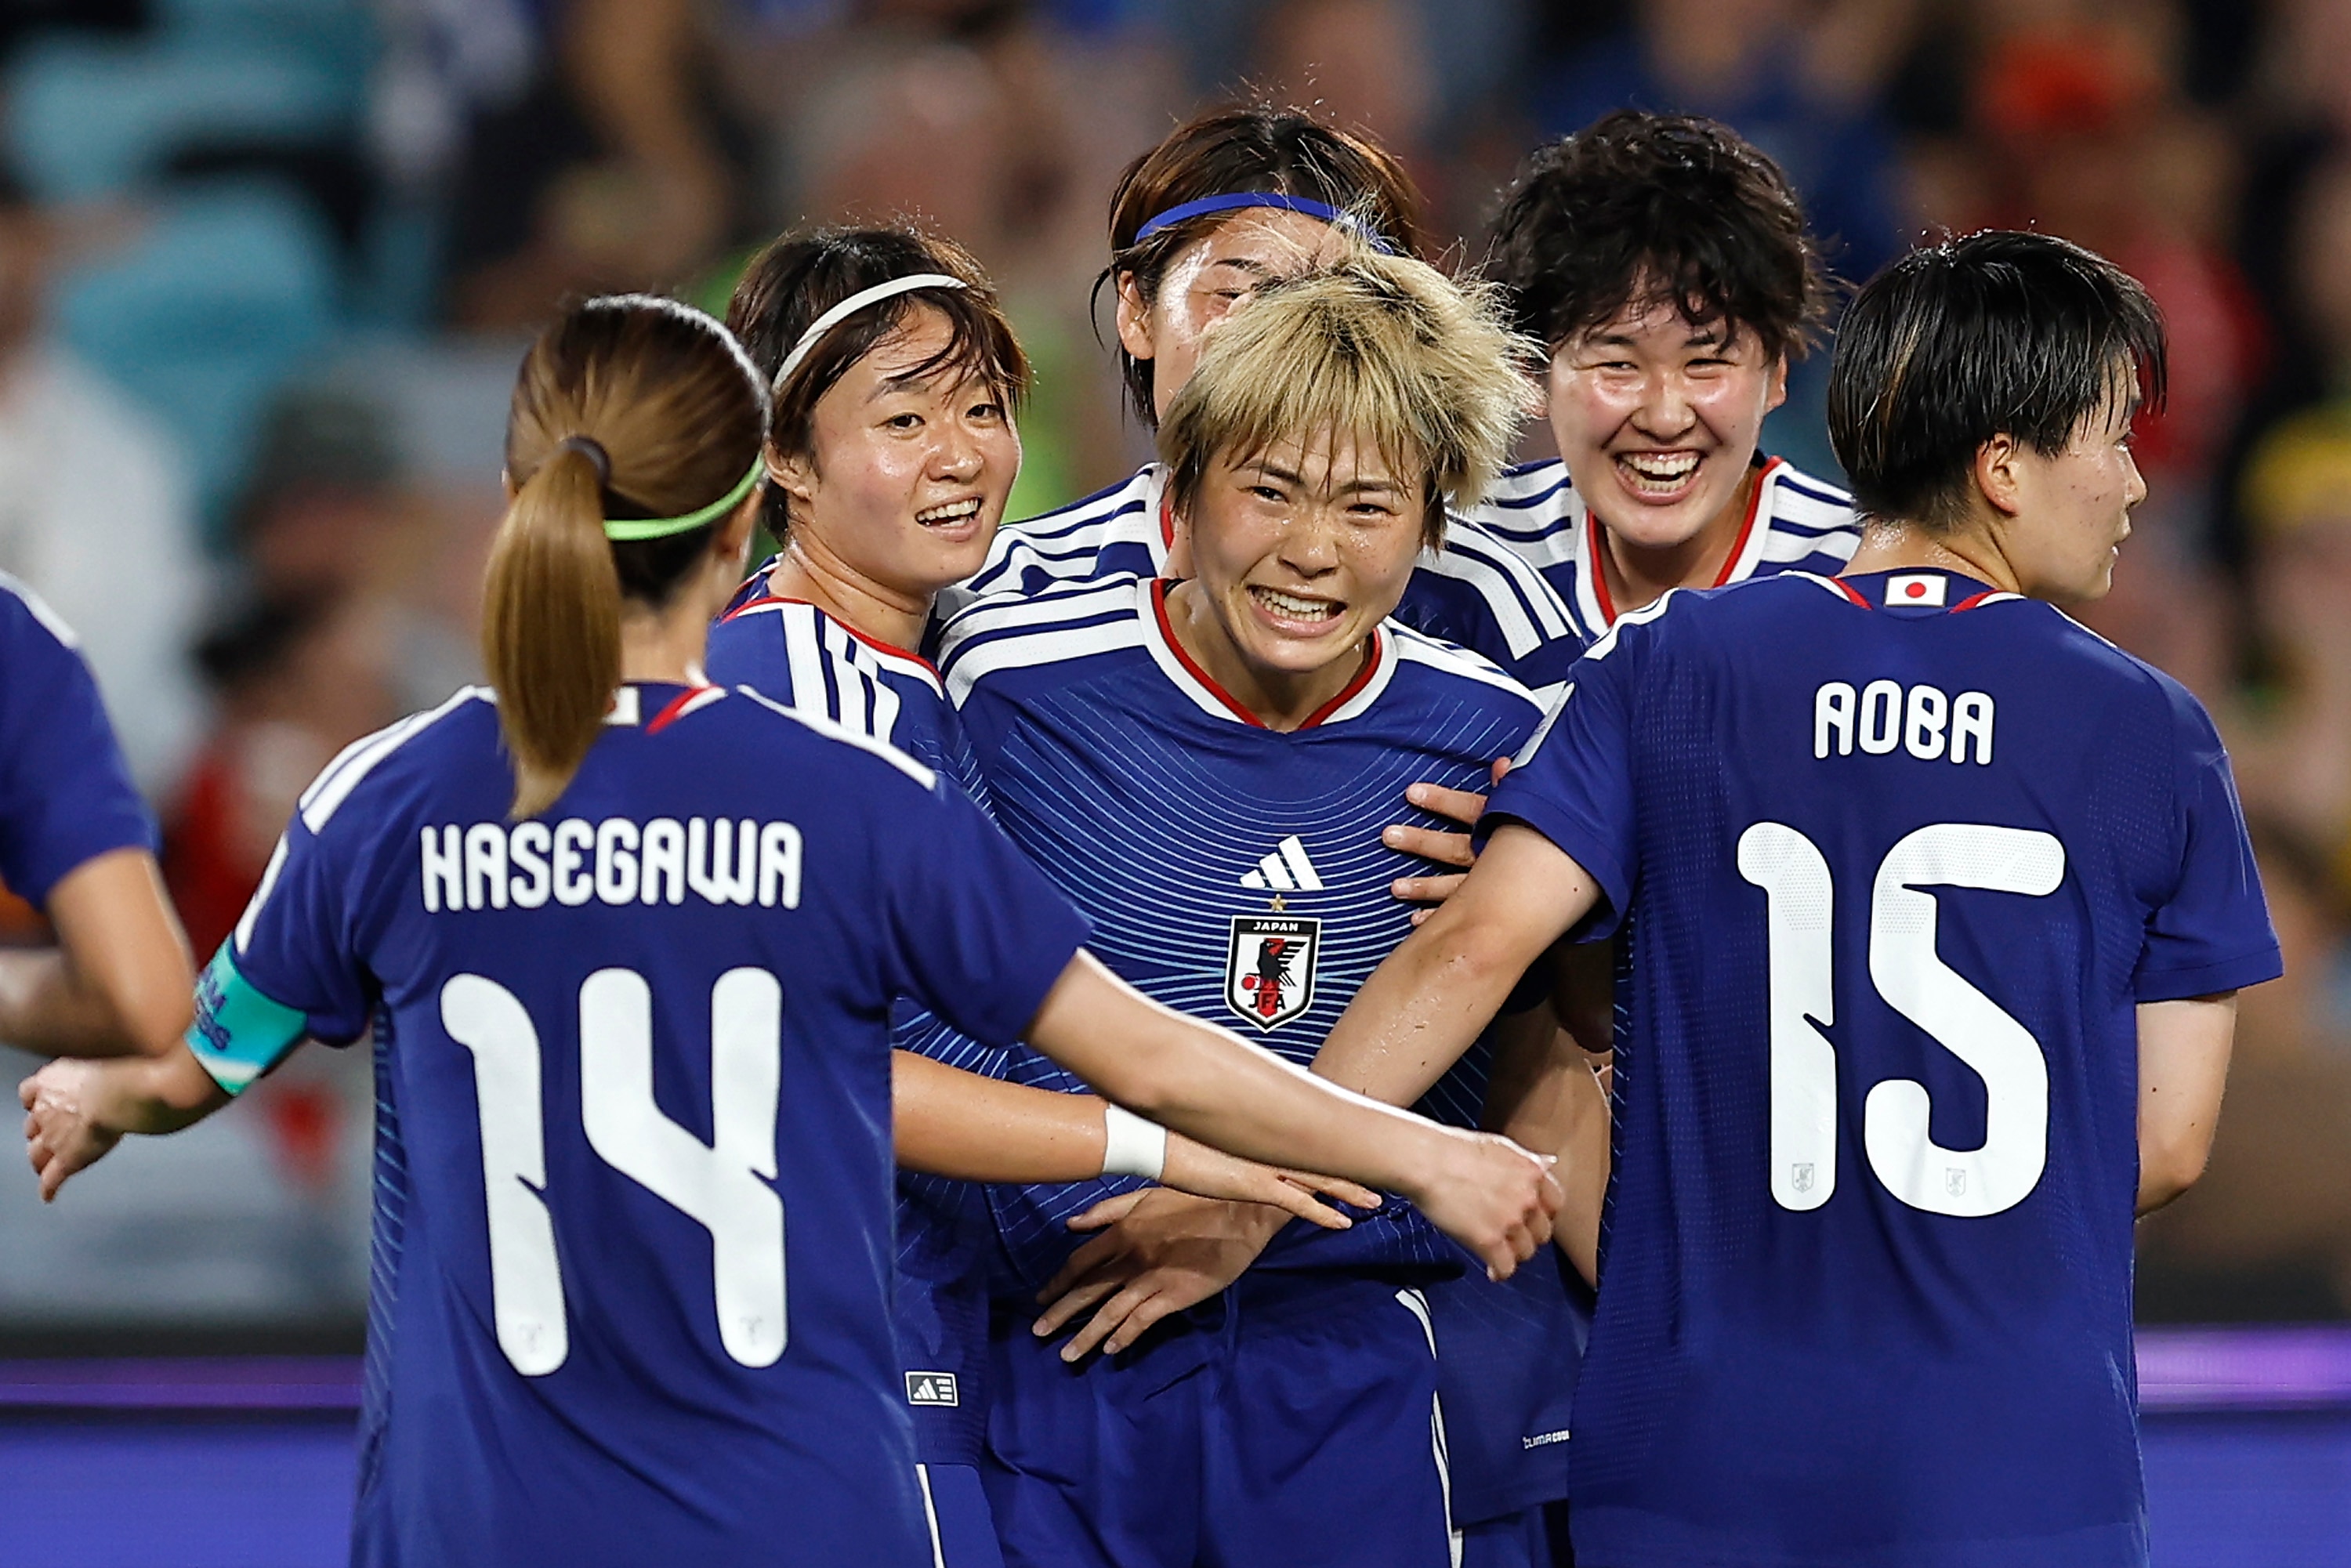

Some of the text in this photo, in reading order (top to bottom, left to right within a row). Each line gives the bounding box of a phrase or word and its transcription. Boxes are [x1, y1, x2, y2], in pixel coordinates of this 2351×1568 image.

[1814, 679, 1994, 765] AOBA
[421, 817, 802, 913] HASEGAWA
[1253, 922, 1299, 932] JAPAN
[1248, 992, 1286, 1010] JFA
[1737, 821, 2065, 1217] 15
[440, 967, 787, 1376] 14
